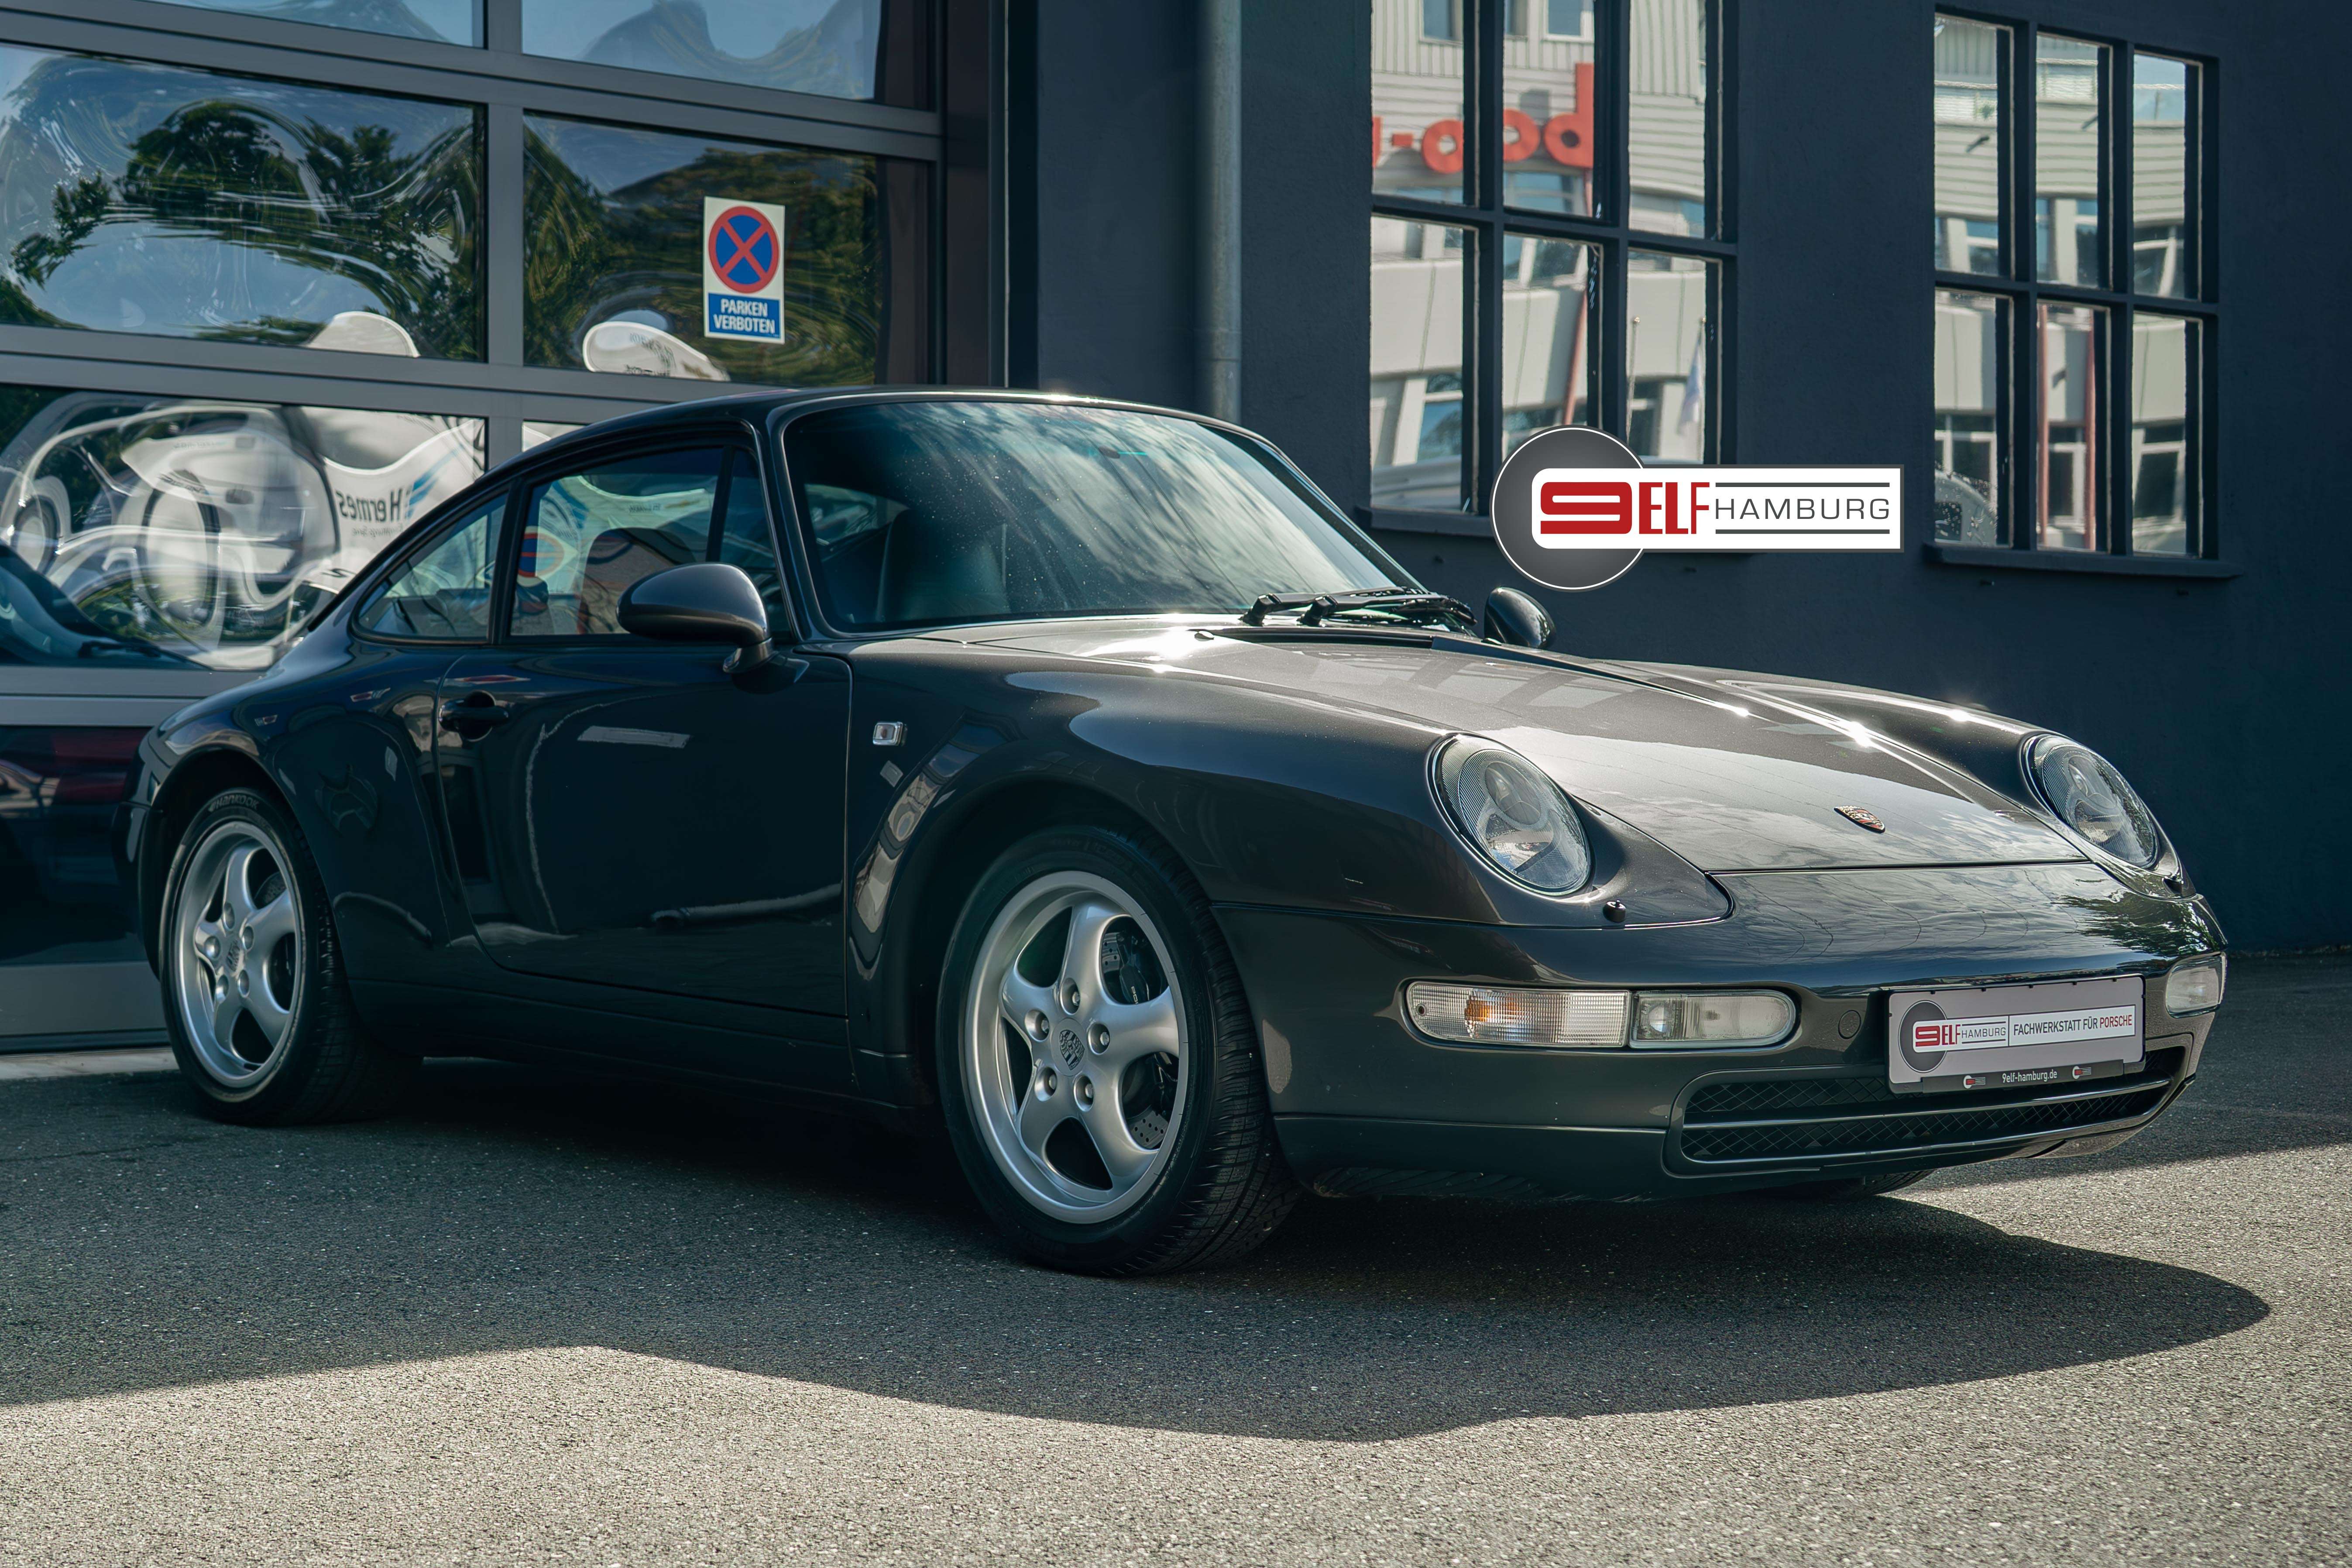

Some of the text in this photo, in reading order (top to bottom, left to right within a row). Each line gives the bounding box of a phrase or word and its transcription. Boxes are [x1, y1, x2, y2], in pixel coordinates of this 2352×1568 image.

[721, 299, 768, 317] PARKEN
[713, 314, 776, 334] VERBOTEN
[1915, 1024, 2006, 1047] 9ELF HAMBURG
[2013, 1015, 2132, 1036] FACHWERKSTATT FÜR PORSCHE
[2002, 1069, 2057, 1083] 9elf-hamburg.de
